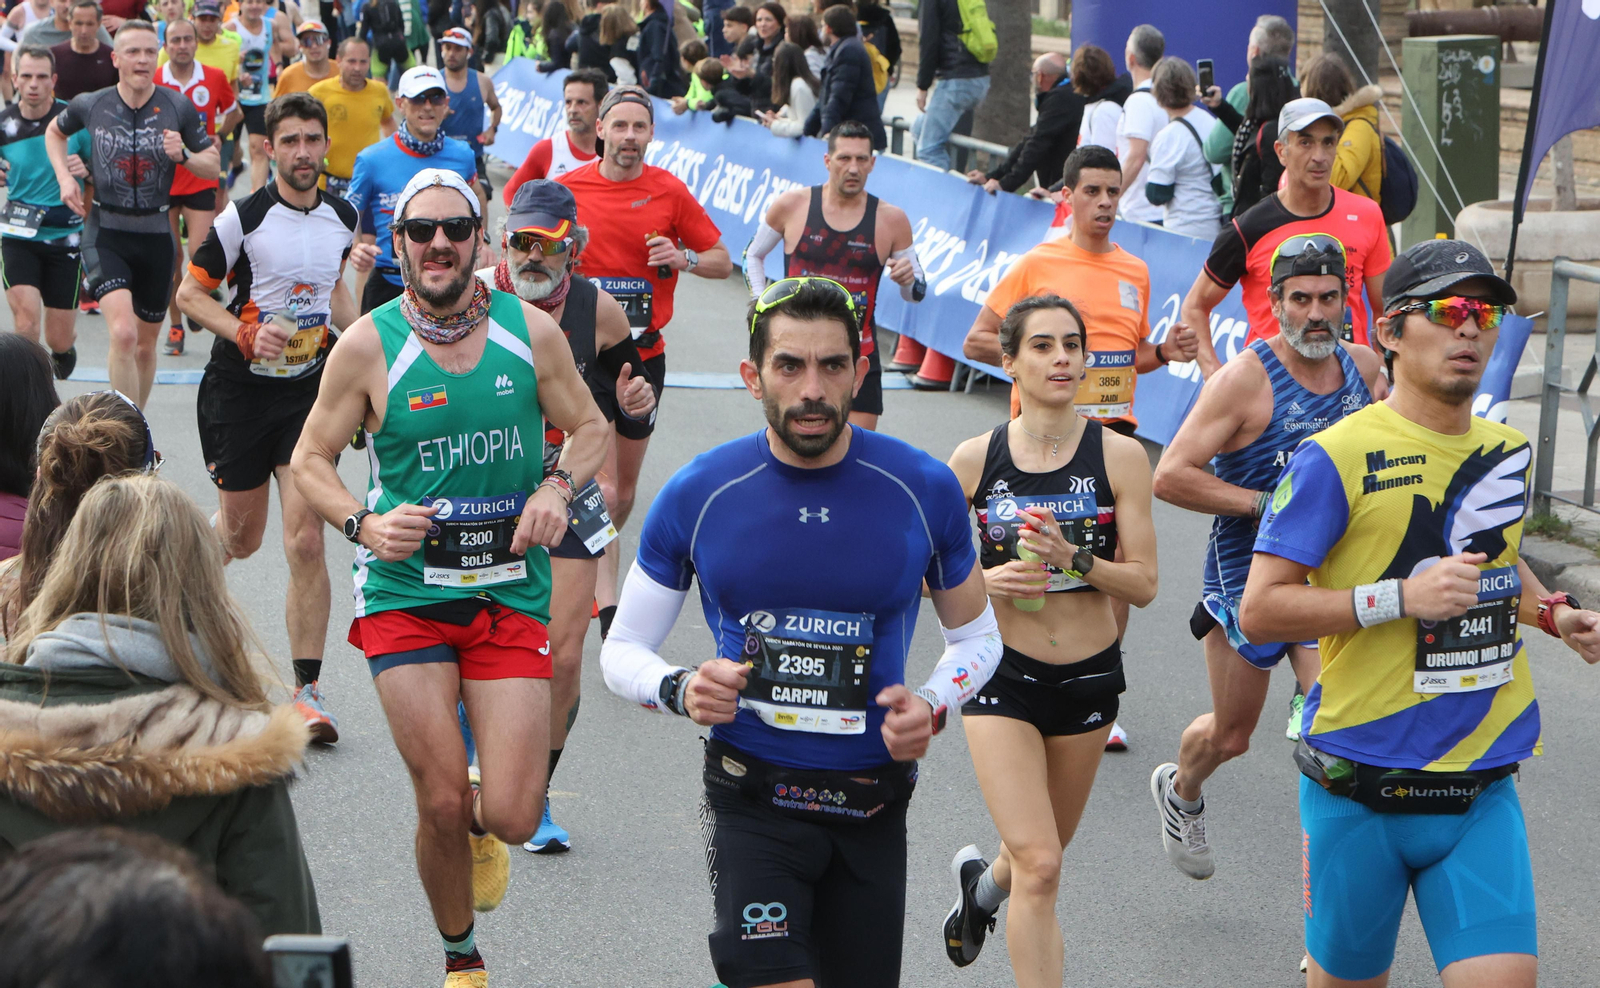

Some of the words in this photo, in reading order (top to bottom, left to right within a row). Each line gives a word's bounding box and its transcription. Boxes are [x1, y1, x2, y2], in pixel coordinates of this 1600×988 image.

[605, 280, 646, 290] ZURICH
[1099, 354, 1132, 365] ZURICH
[1098, 376, 1121, 387] 3856
[1100, 394, 1119, 403] ZAIDI
[417, 425, 524, 472] ETHIOPIA
[1365, 449, 1427, 474] Mercury
[1362, 473, 1424, 496] Runners
[459, 498, 515, 515] ZURICH
[459, 529, 494, 547] 2300
[460, 551, 493, 567] SOLÍS
[784, 614, 861, 637] ZURICH
[1459, 615, 1493, 638] 2441
[777, 653, 826, 677] 2395
[1425, 649, 1479, 668] URUMQI
[1480, 645, 1499, 663] MID
[1500, 642, 1513, 658] RD
[771, 685, 829, 706] CARPIN
